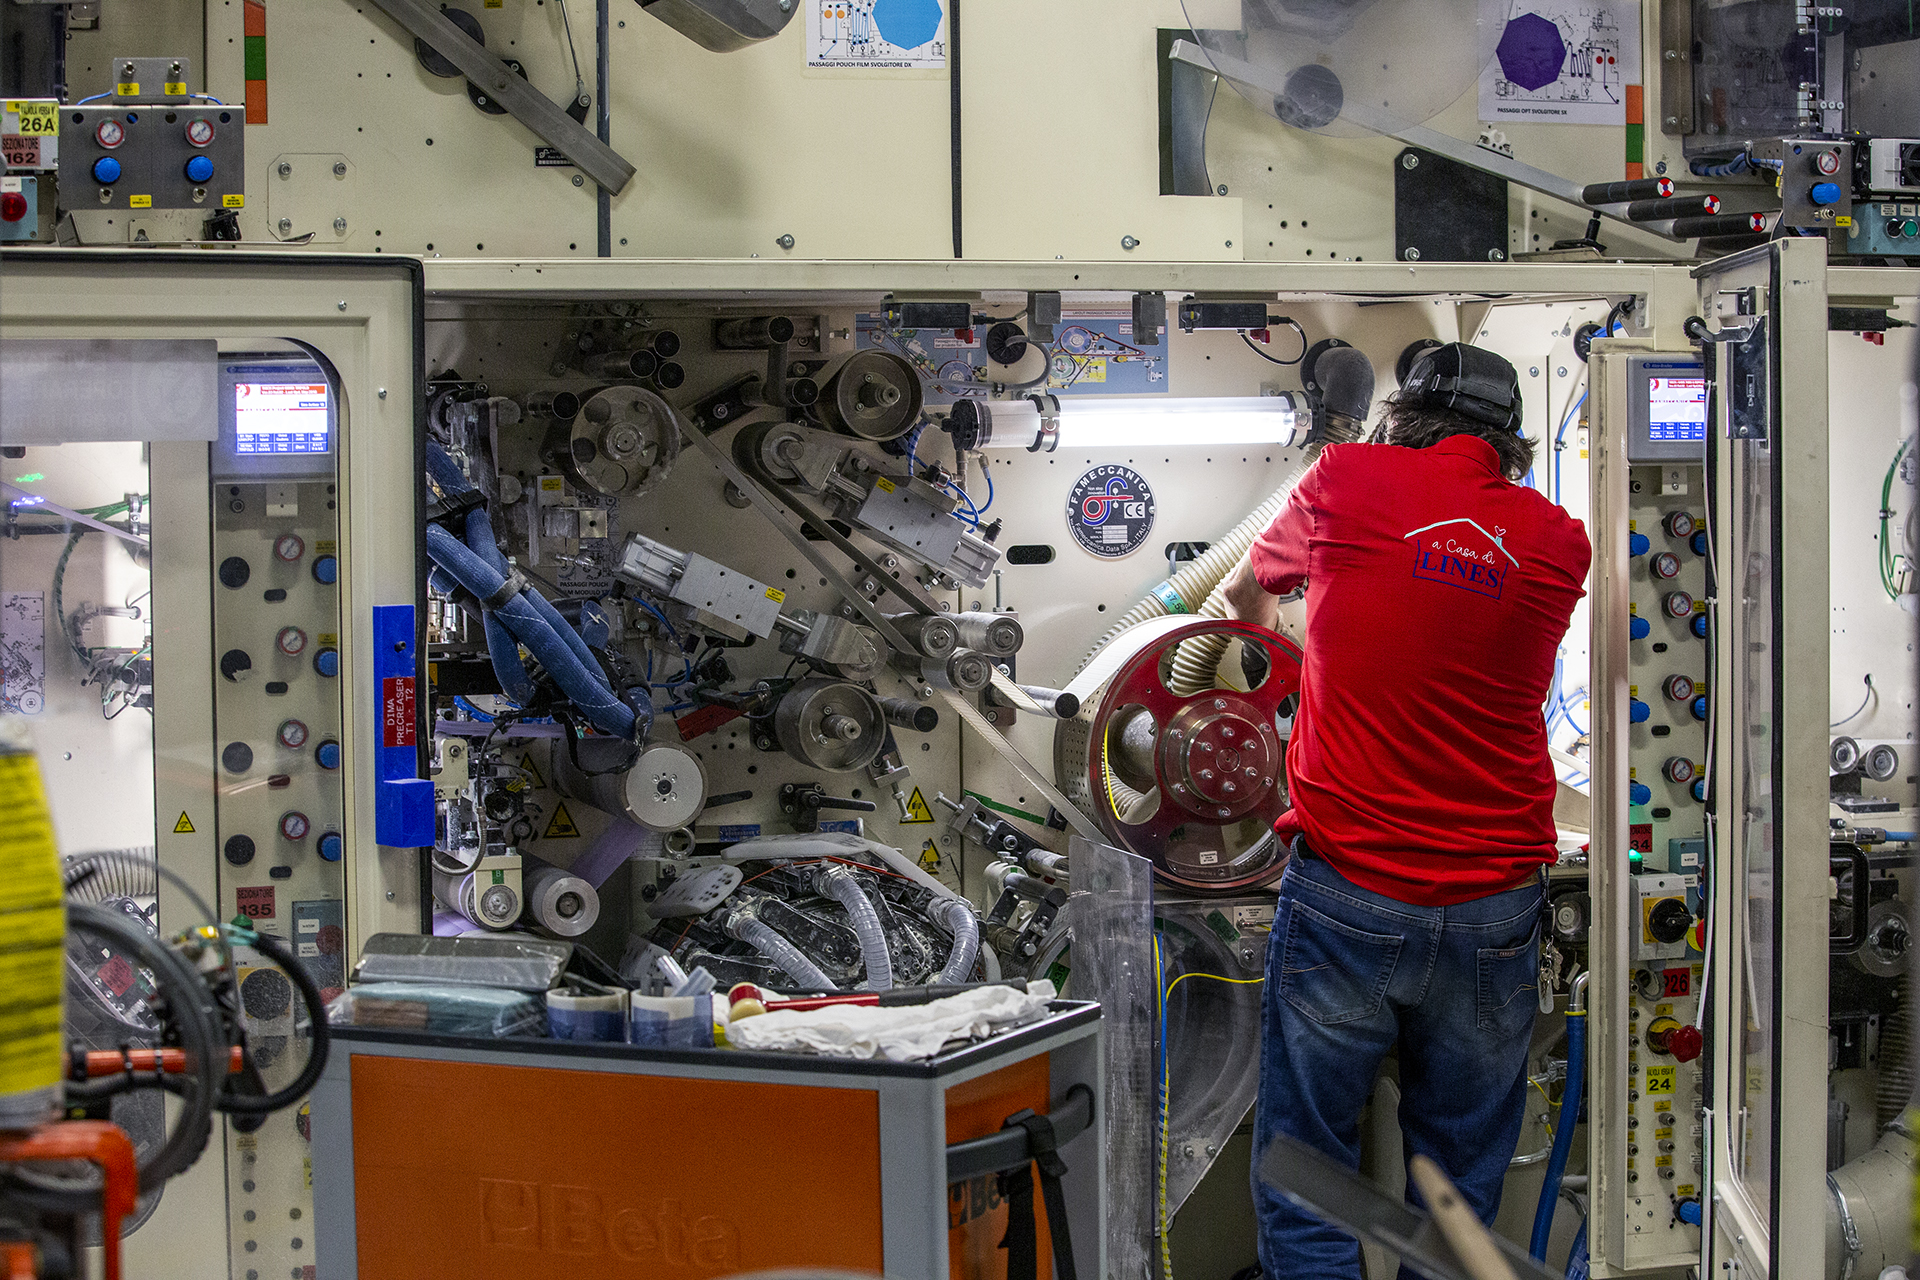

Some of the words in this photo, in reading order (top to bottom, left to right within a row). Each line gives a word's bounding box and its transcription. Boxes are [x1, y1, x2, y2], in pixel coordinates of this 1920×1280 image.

[21, 118, 54, 132] 26A
[2, 137, 38, 150] SEZIONATORE
[5, 152, 36, 164] 162
[1071, 466, 1151, 504] FAMECCANICA
[1126, 504, 1143, 517] CE
[1135, 522, 1147, 539] ITALY
[1432, 541, 1442, 550] a
[1446, 539, 1478, 559] Casa
[1420, 551, 1500, 588] LINES
[405, 688, 413, 701] T2
[387, 698, 395, 726] DIMA
[396, 678, 405, 745] PRECREASER
[406, 722, 413, 735] T1
[1631, 839, 1650, 850] 34
[240, 904, 271, 916] 135
[1649, 1078, 1671, 1091] 24
[551, 1184, 742, 1269] Beta
